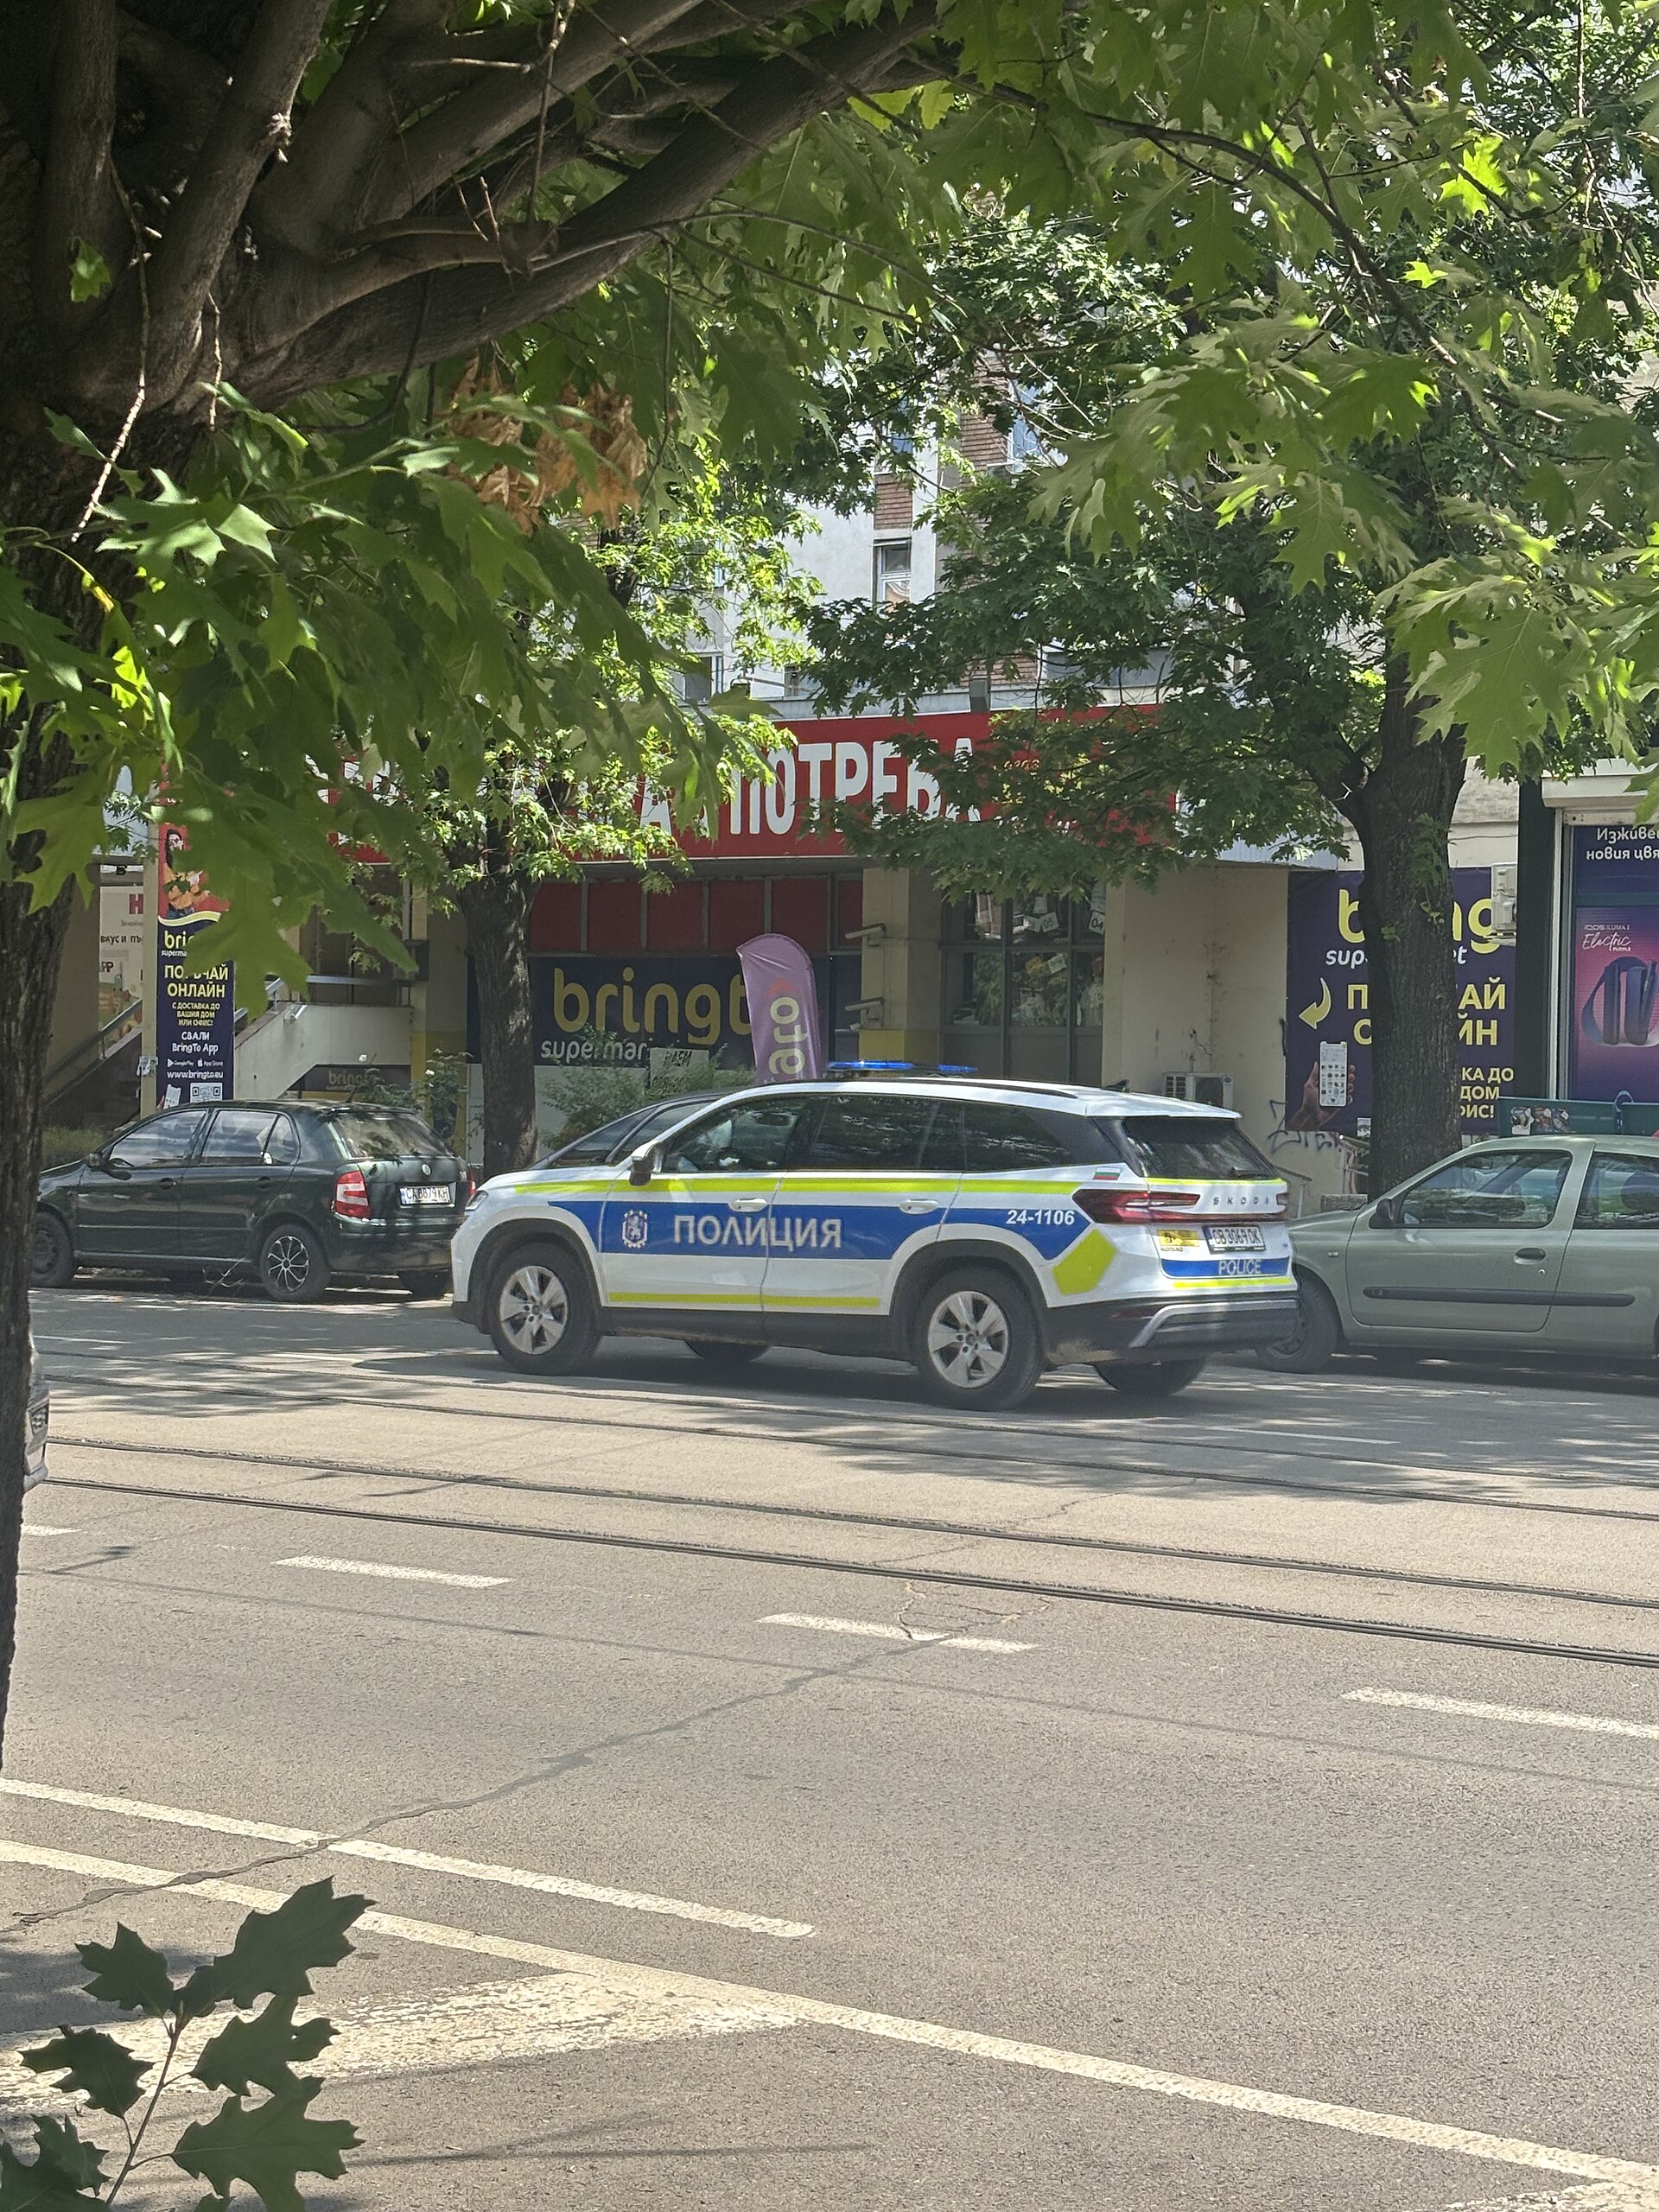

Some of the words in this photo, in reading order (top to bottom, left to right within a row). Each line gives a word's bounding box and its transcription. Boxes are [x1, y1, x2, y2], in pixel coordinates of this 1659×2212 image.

[691, 737, 982, 835] ПОТРЕБ
[1586, 846, 1630, 860] новия
[1634, 846, 1659, 861] цвя
[1091, 918, 1103, 931] 04
[1582, 931, 1631, 951] Electric
[167, 981, 226, 998] ОНЛАЙН
[553, 966, 752, 1046] bringt
[181, 1031, 210, 1040] СВАЛИ
[202, 1043, 219, 1056] App
[167, 1070, 224, 1080] www.bringto.eu
[1487, 1067, 1515, 1084] ДО
[1005, 1209, 1076, 1225] 24-1106
[674, 1215, 842, 1252] ПОЛИЦИЯ
[1218, 1258, 1262, 1276] POLICE
